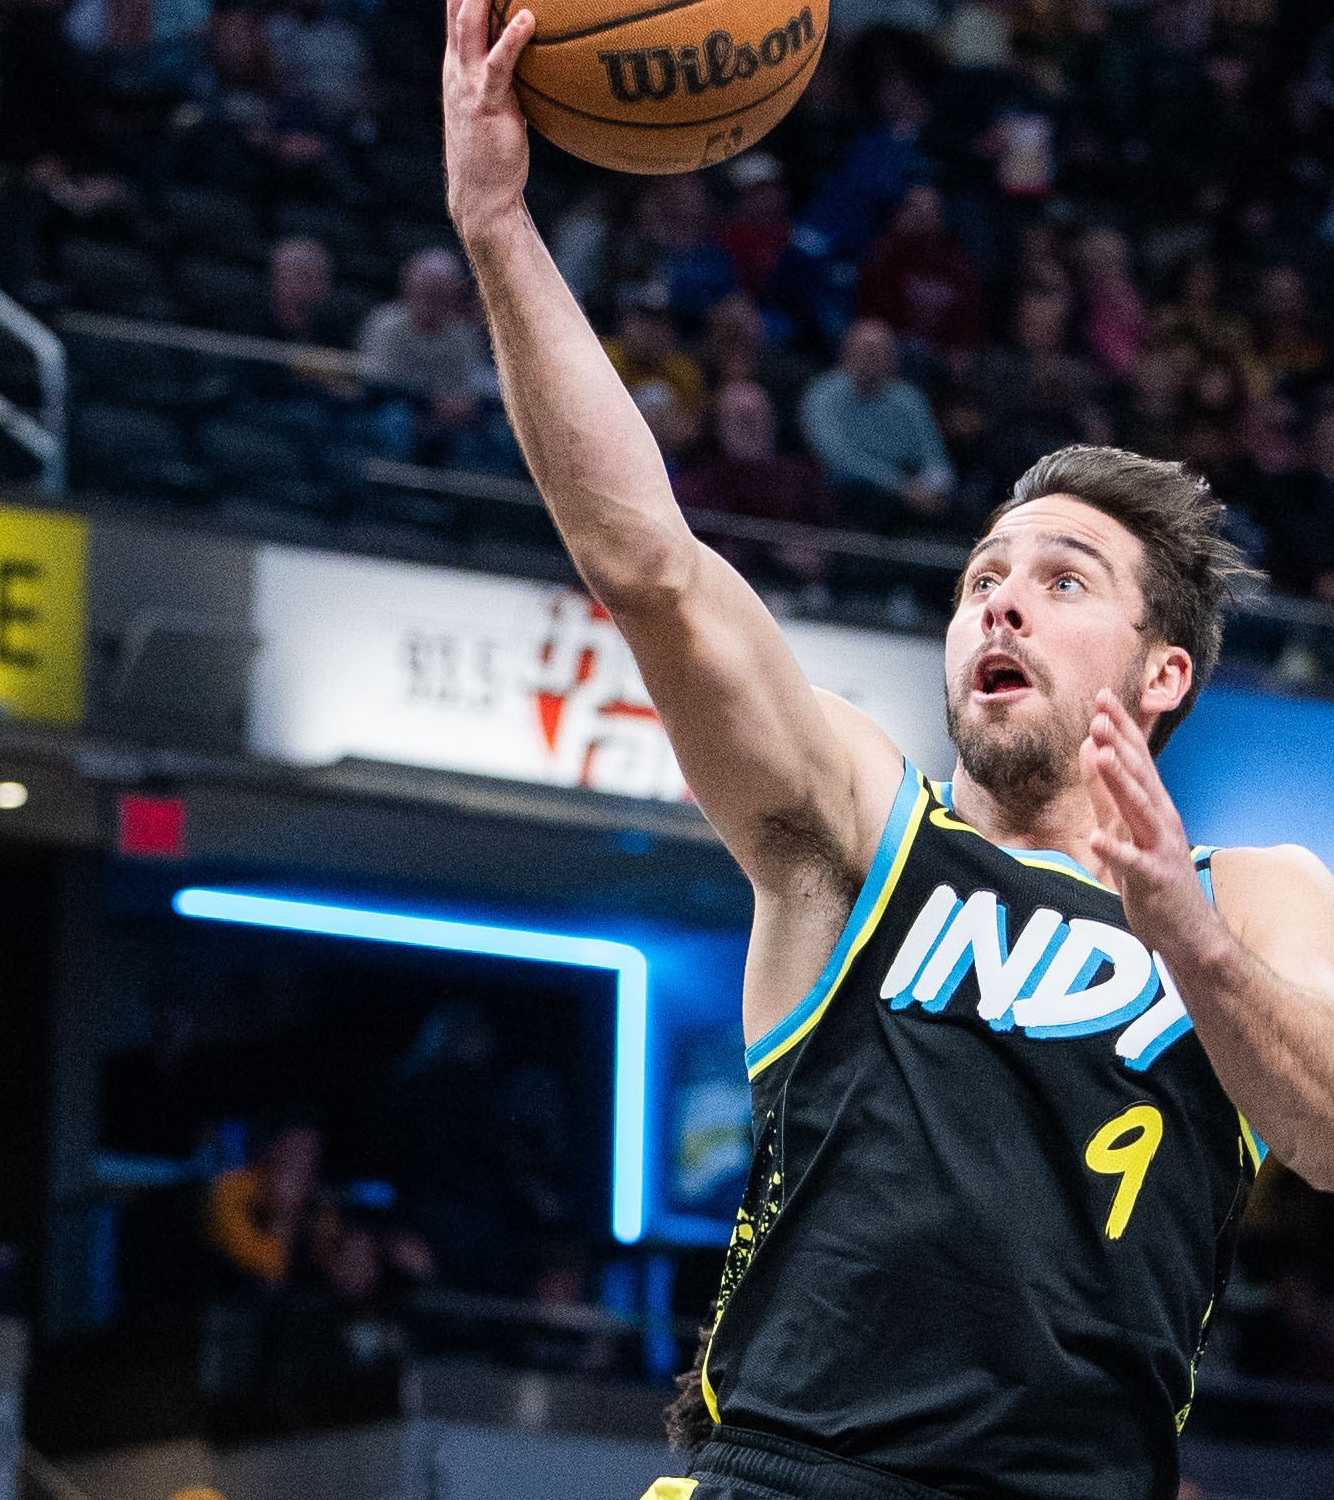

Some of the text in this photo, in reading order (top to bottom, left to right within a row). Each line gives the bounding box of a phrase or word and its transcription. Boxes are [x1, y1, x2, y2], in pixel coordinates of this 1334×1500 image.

[597, 6, 814, 105] Wilson
[879, 883, 1195, 1072] INDY
[1085, 1104, 1164, 1240] 9
